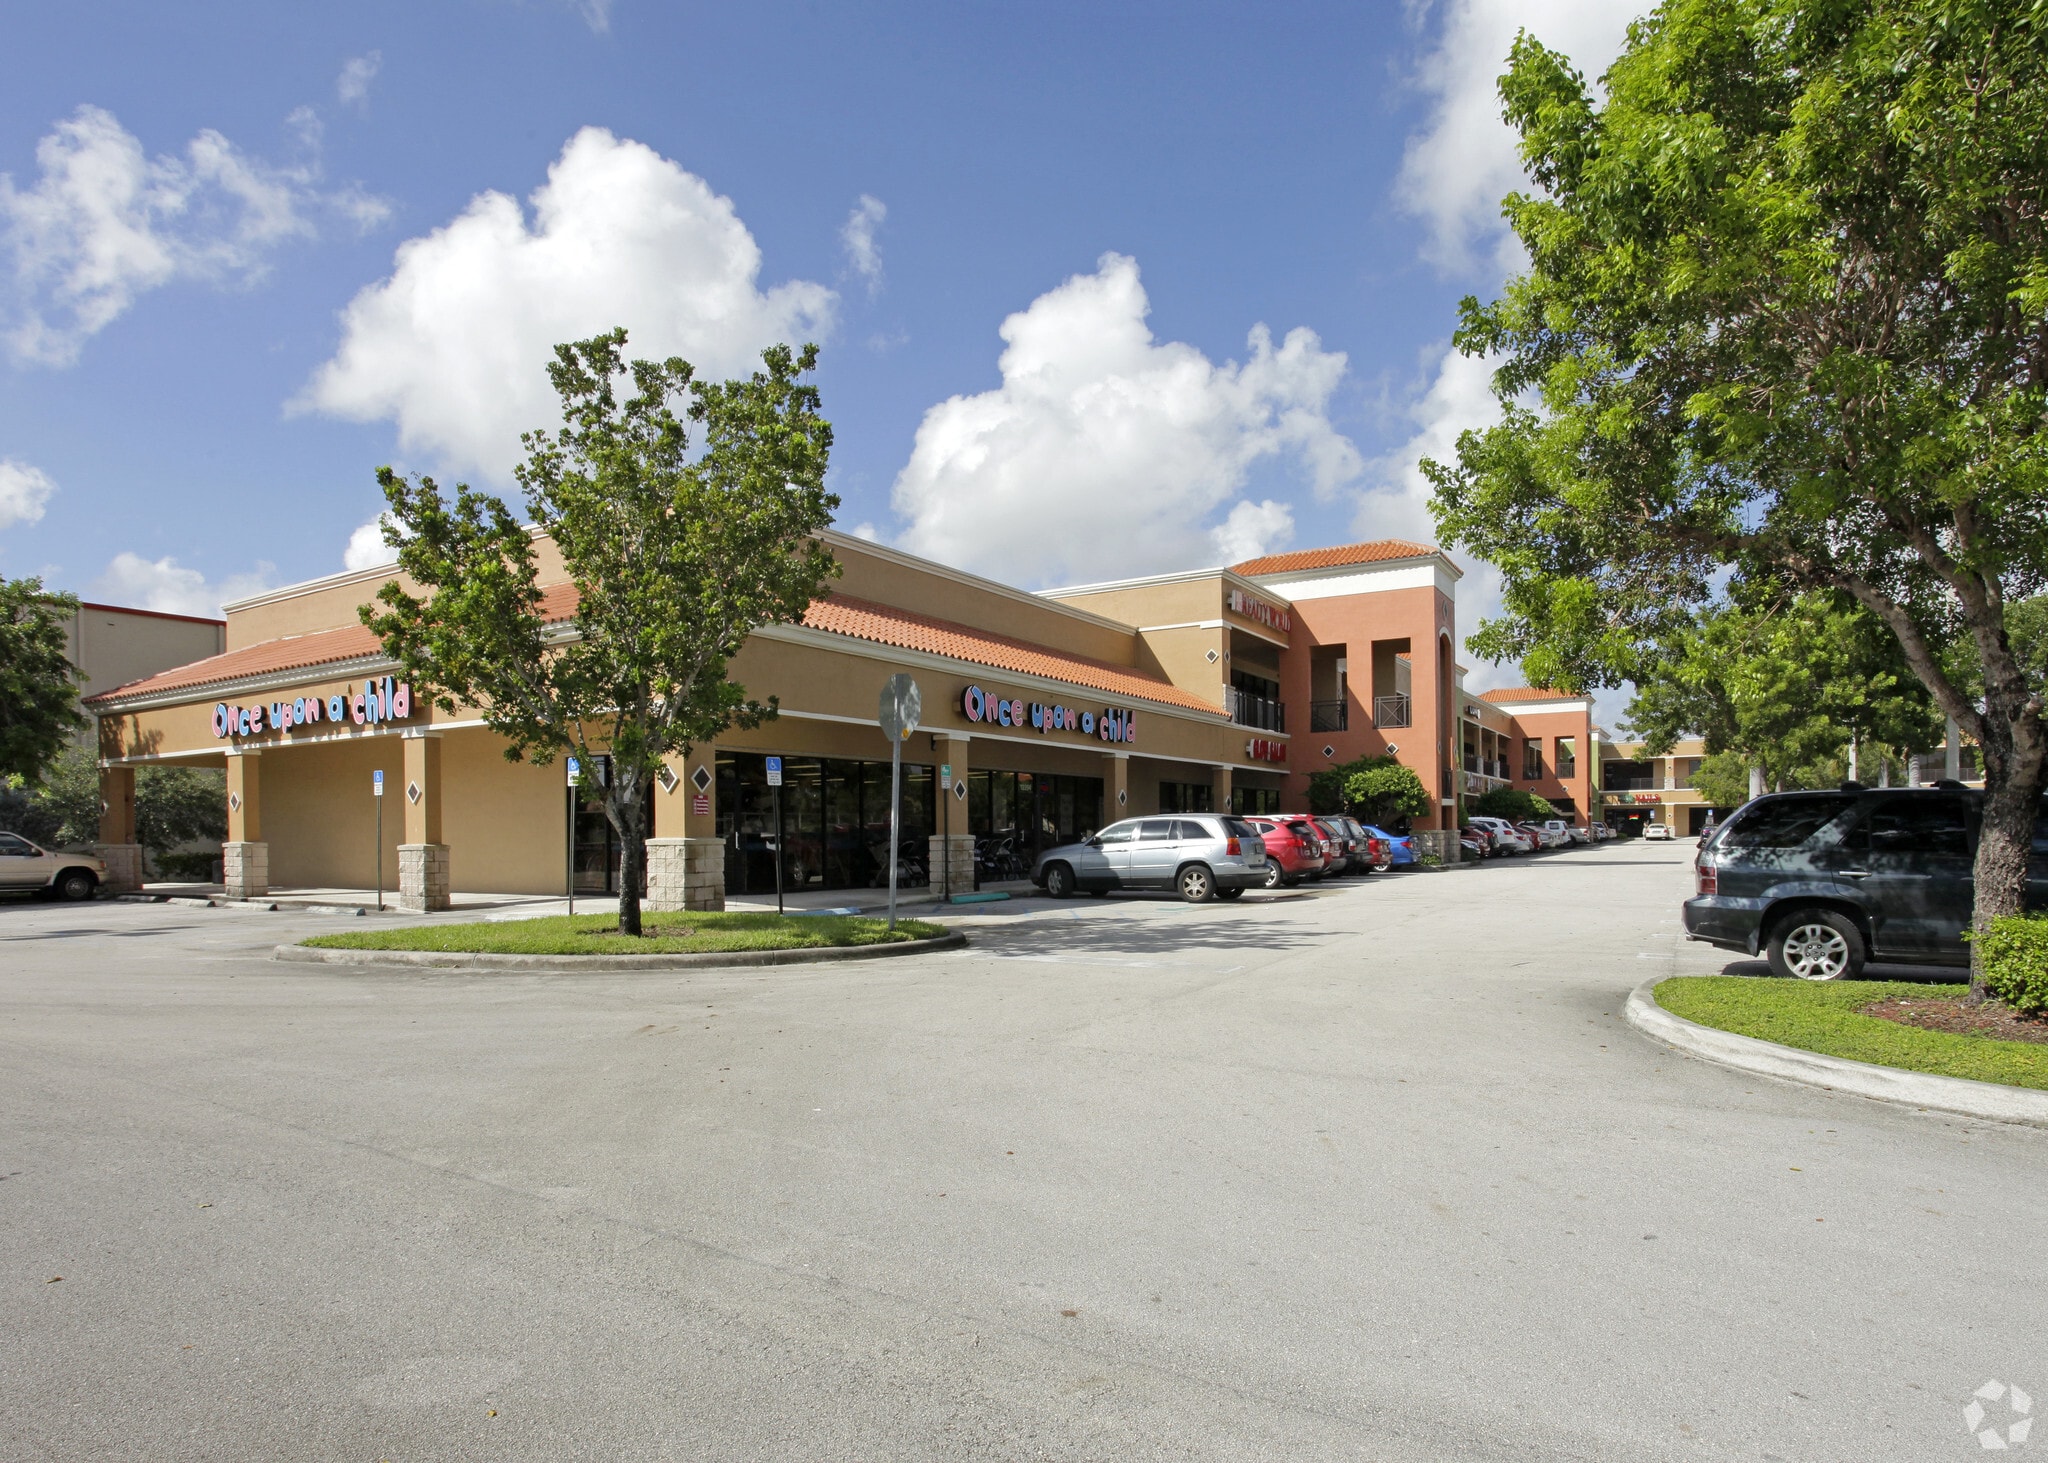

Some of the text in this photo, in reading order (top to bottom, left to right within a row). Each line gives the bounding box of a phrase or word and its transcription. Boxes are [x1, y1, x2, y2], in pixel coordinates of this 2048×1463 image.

[211, 676, 410, 738] Once upon a child
[964, 685, 1136, 744] Once upon a child
[1635, 794, 1661, 802] NAILS
